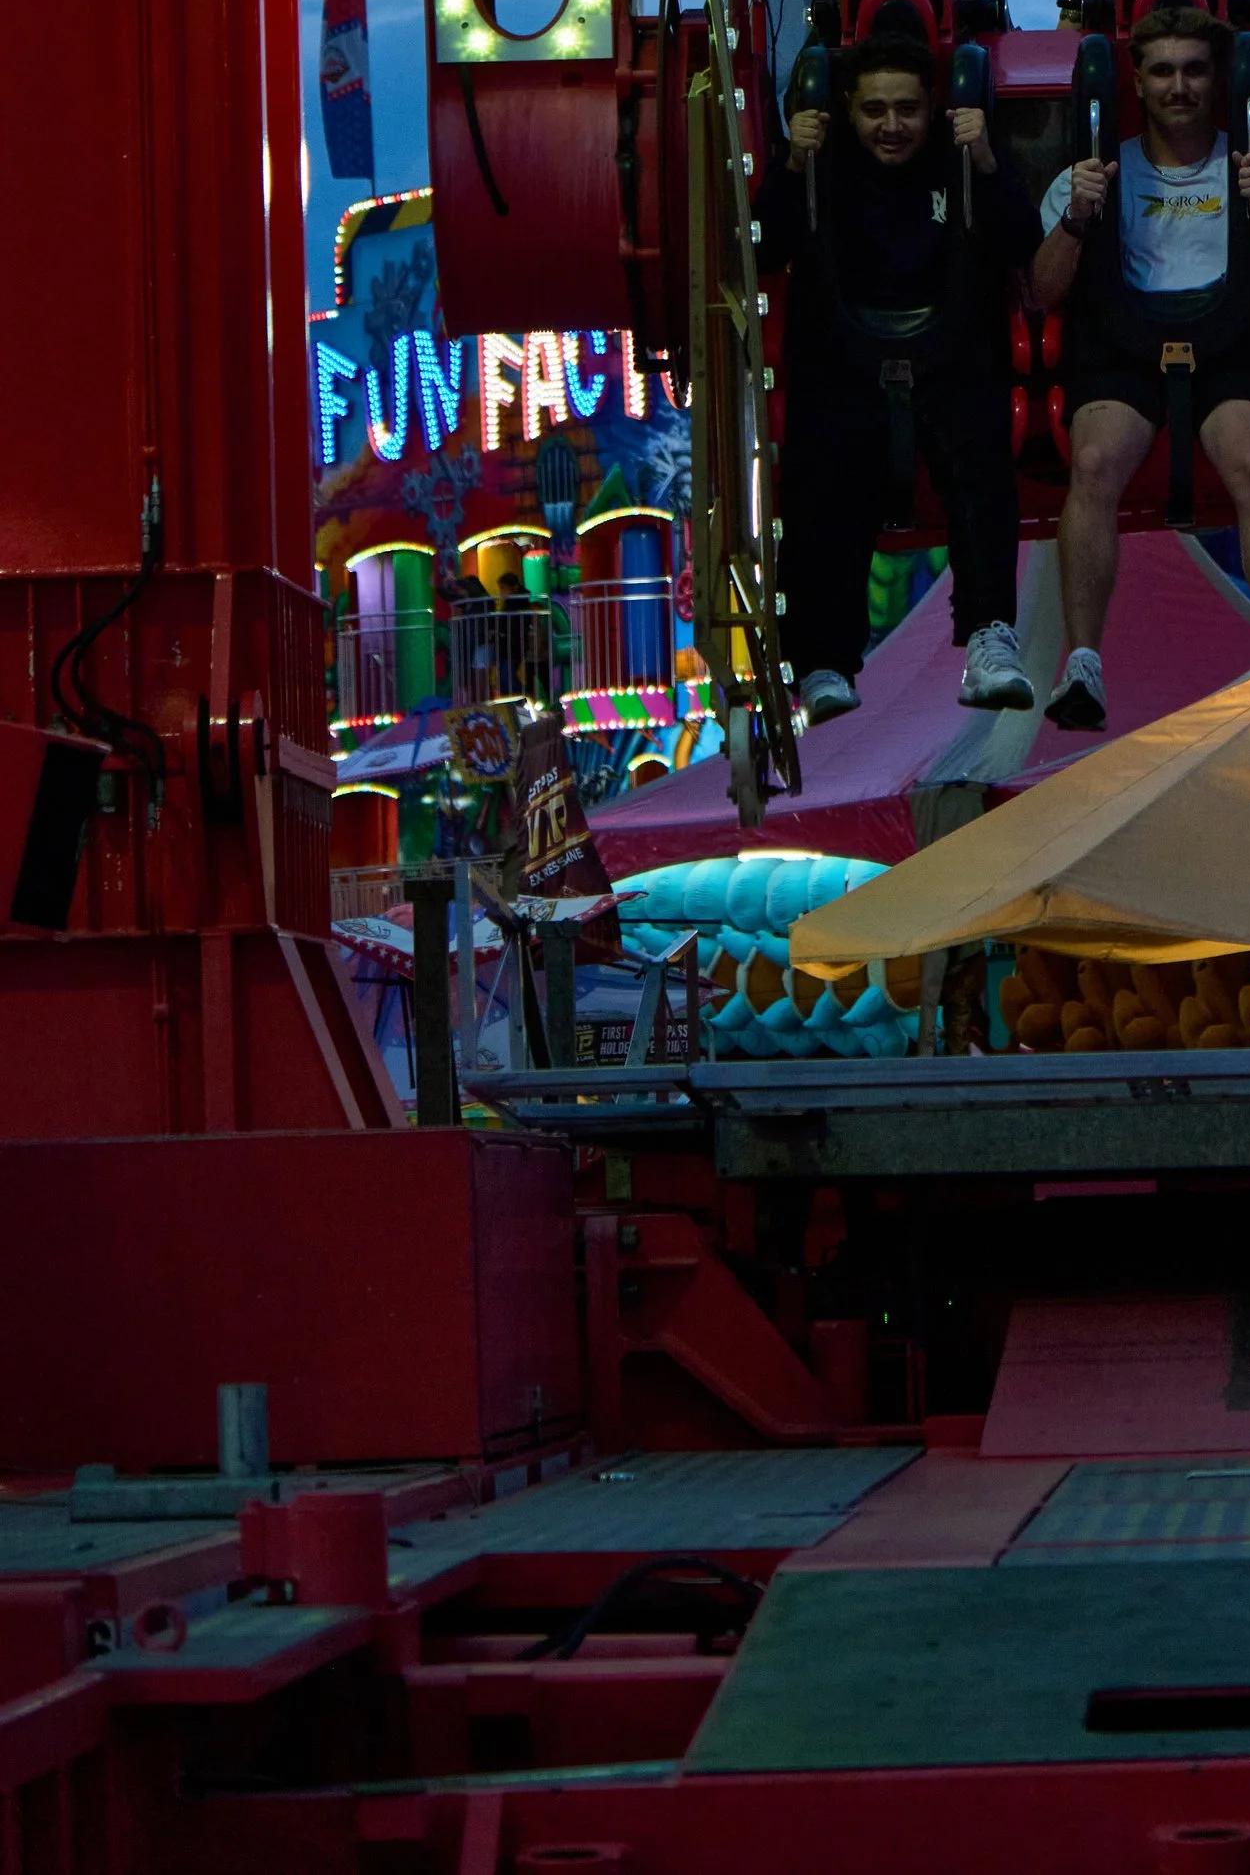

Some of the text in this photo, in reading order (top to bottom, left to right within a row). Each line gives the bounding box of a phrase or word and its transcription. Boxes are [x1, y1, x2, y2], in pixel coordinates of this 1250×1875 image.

[314, 328, 464, 465] FUN
[602, 1026, 627, 1040] FIRST
[600, 1041, 630, 1055] HOLDE
